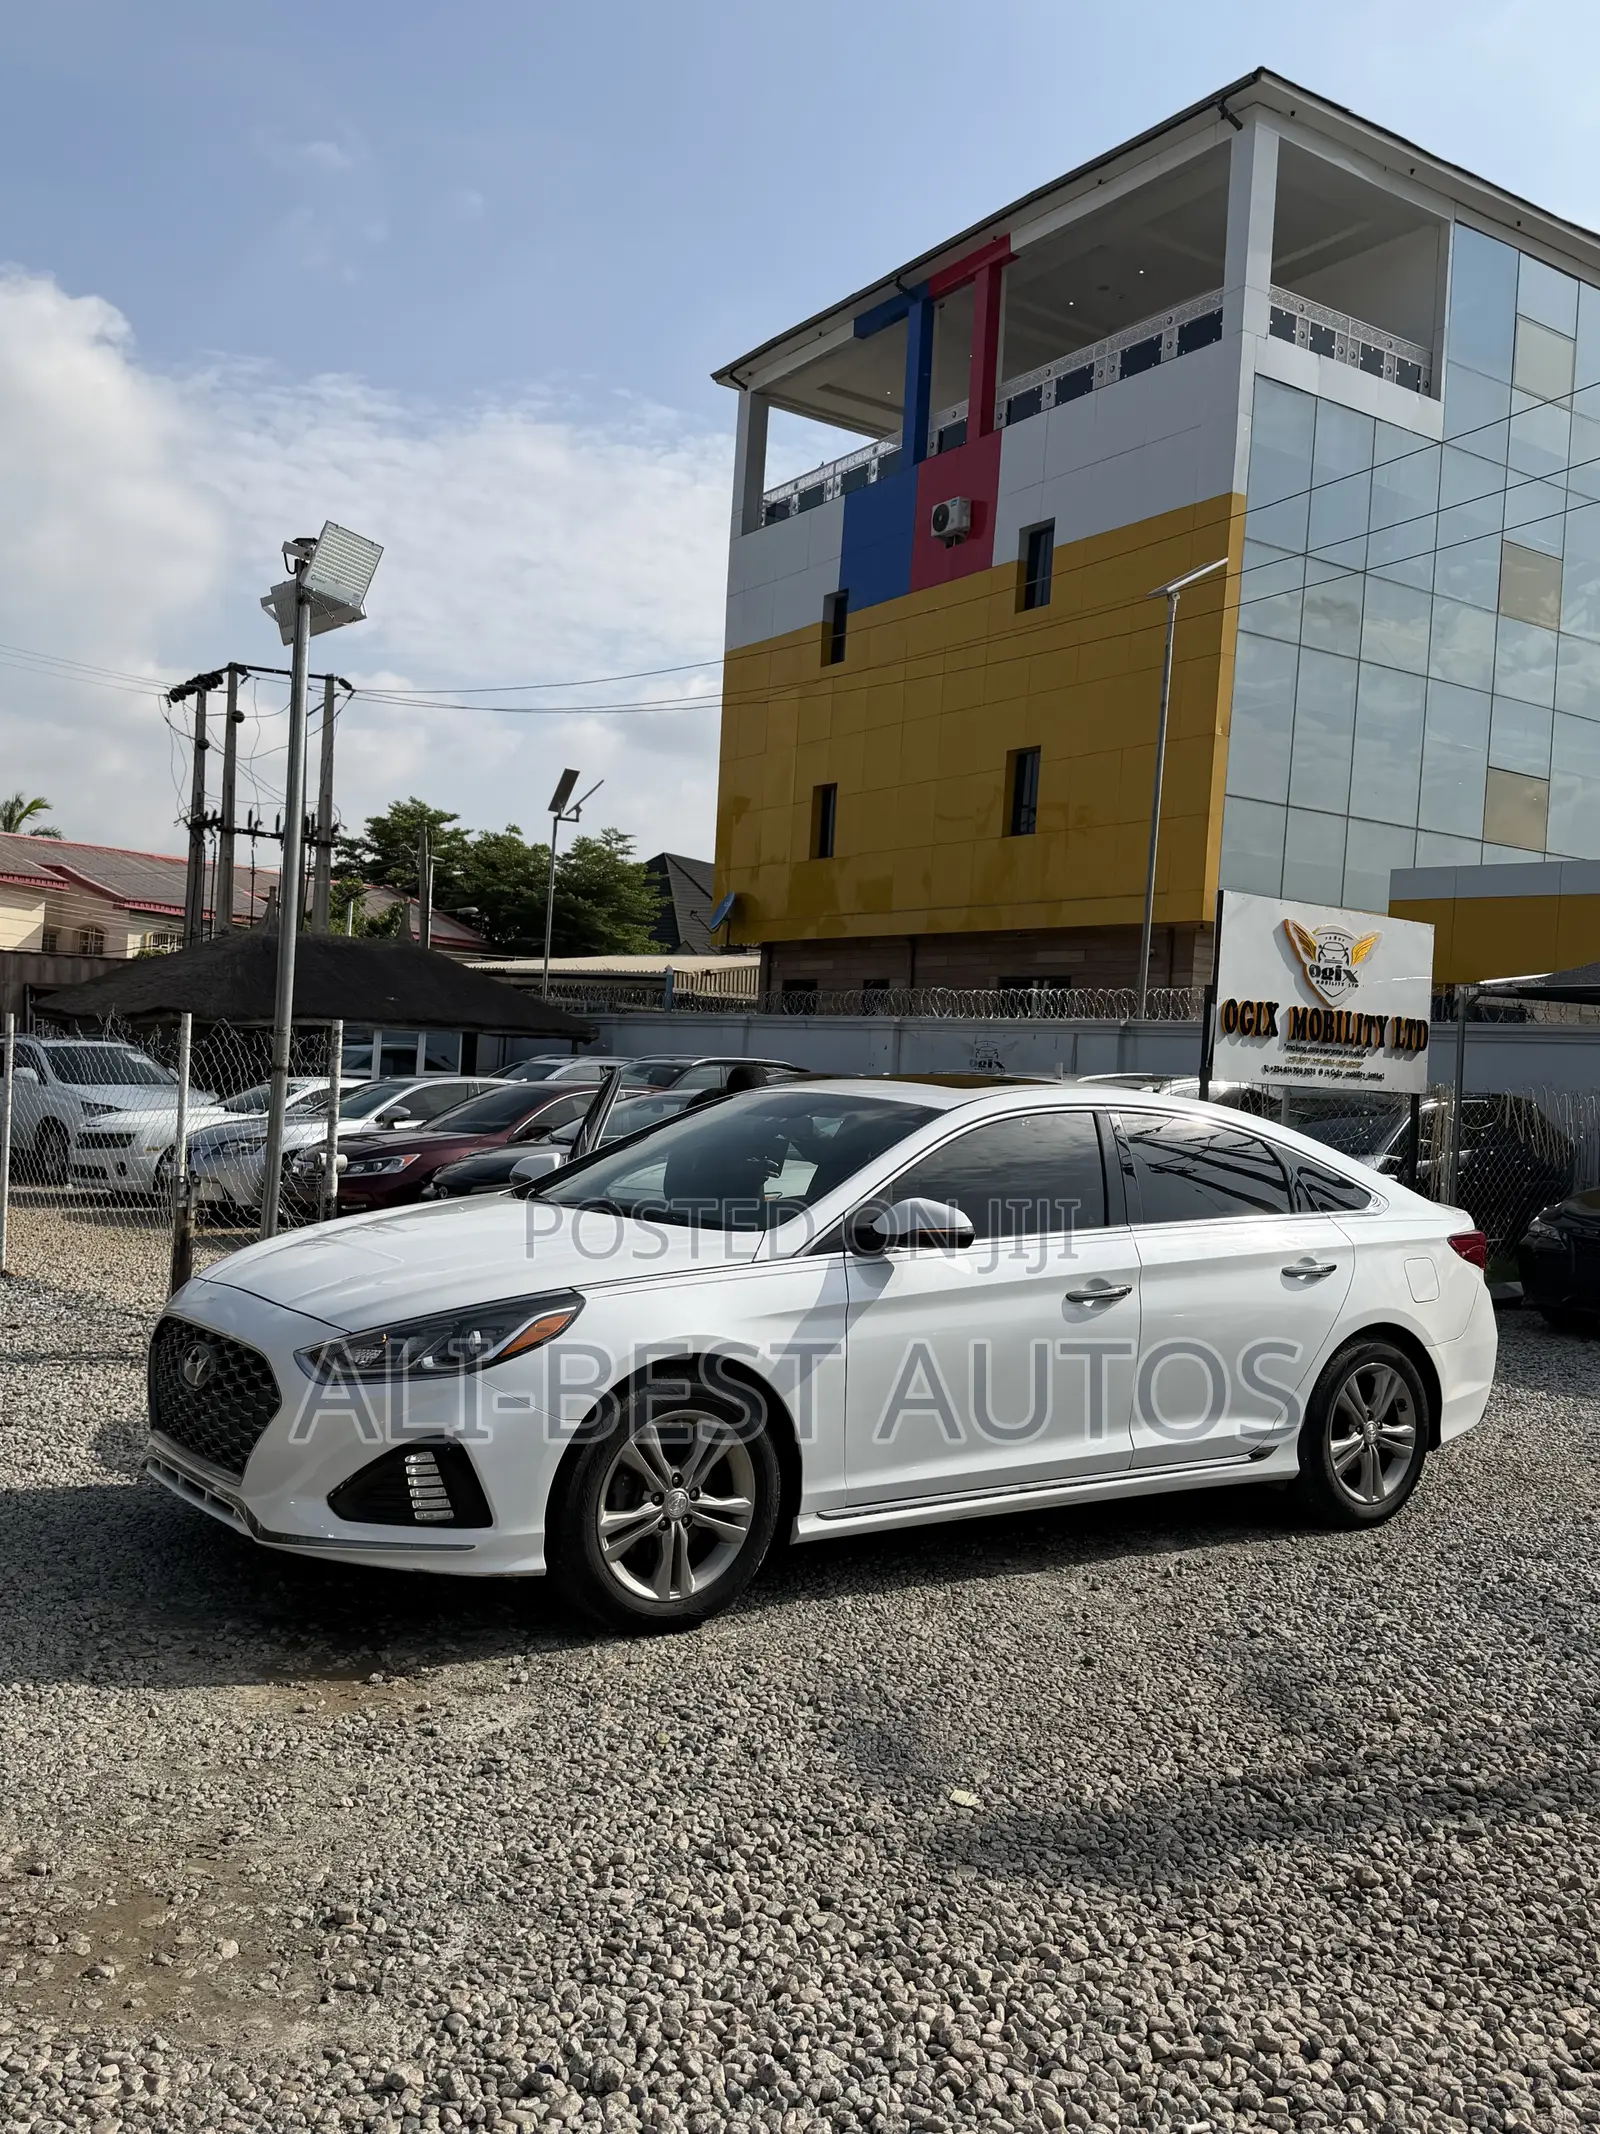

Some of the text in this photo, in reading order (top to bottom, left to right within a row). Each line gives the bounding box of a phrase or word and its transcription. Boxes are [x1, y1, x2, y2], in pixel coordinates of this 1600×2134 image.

[1221, 998, 1429, 1052] OGIX MOBILITY LTD
